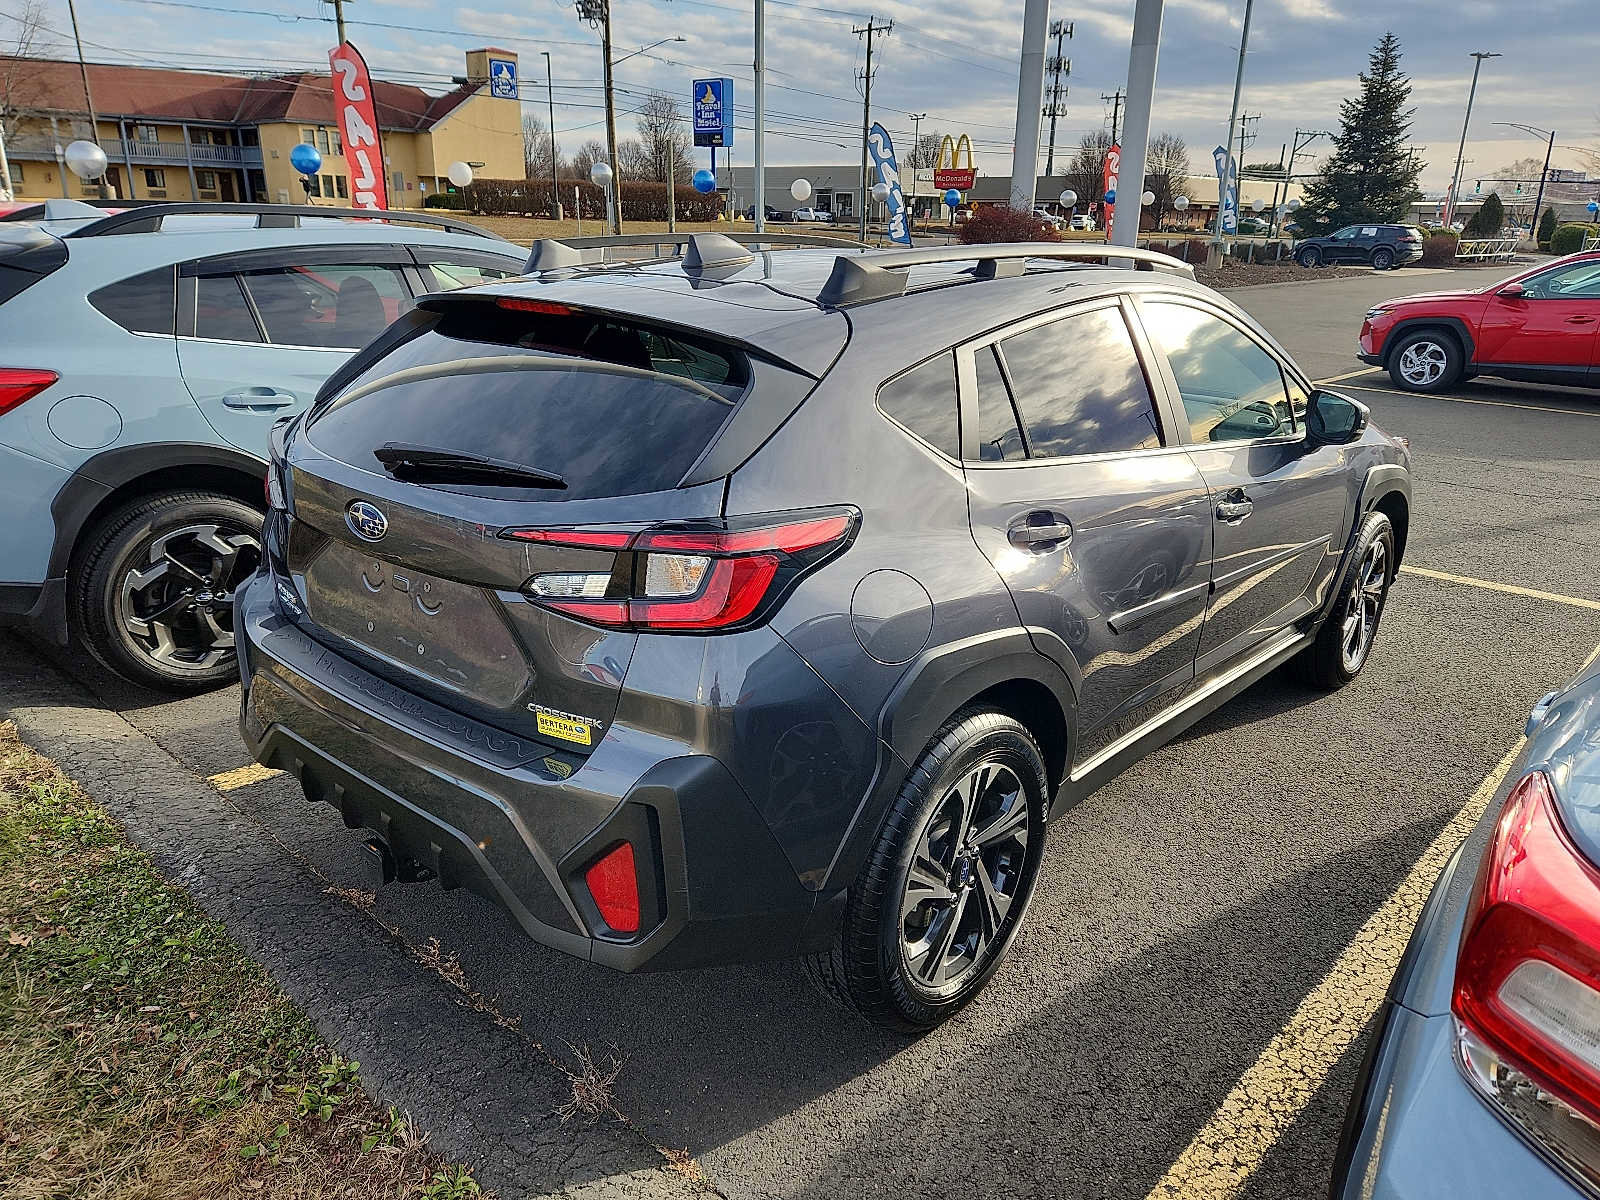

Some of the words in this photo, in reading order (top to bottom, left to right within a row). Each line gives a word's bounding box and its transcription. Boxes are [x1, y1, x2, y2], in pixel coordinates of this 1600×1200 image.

[696, 100, 721, 111] Travel
[701, 110, 716, 119] Inn
[697, 118, 721, 128] Motel
[935, 173, 972, 182] McDonald's
[527, 702, 604, 730] CROSSTREK
[540, 717, 575, 733] BERTERA
